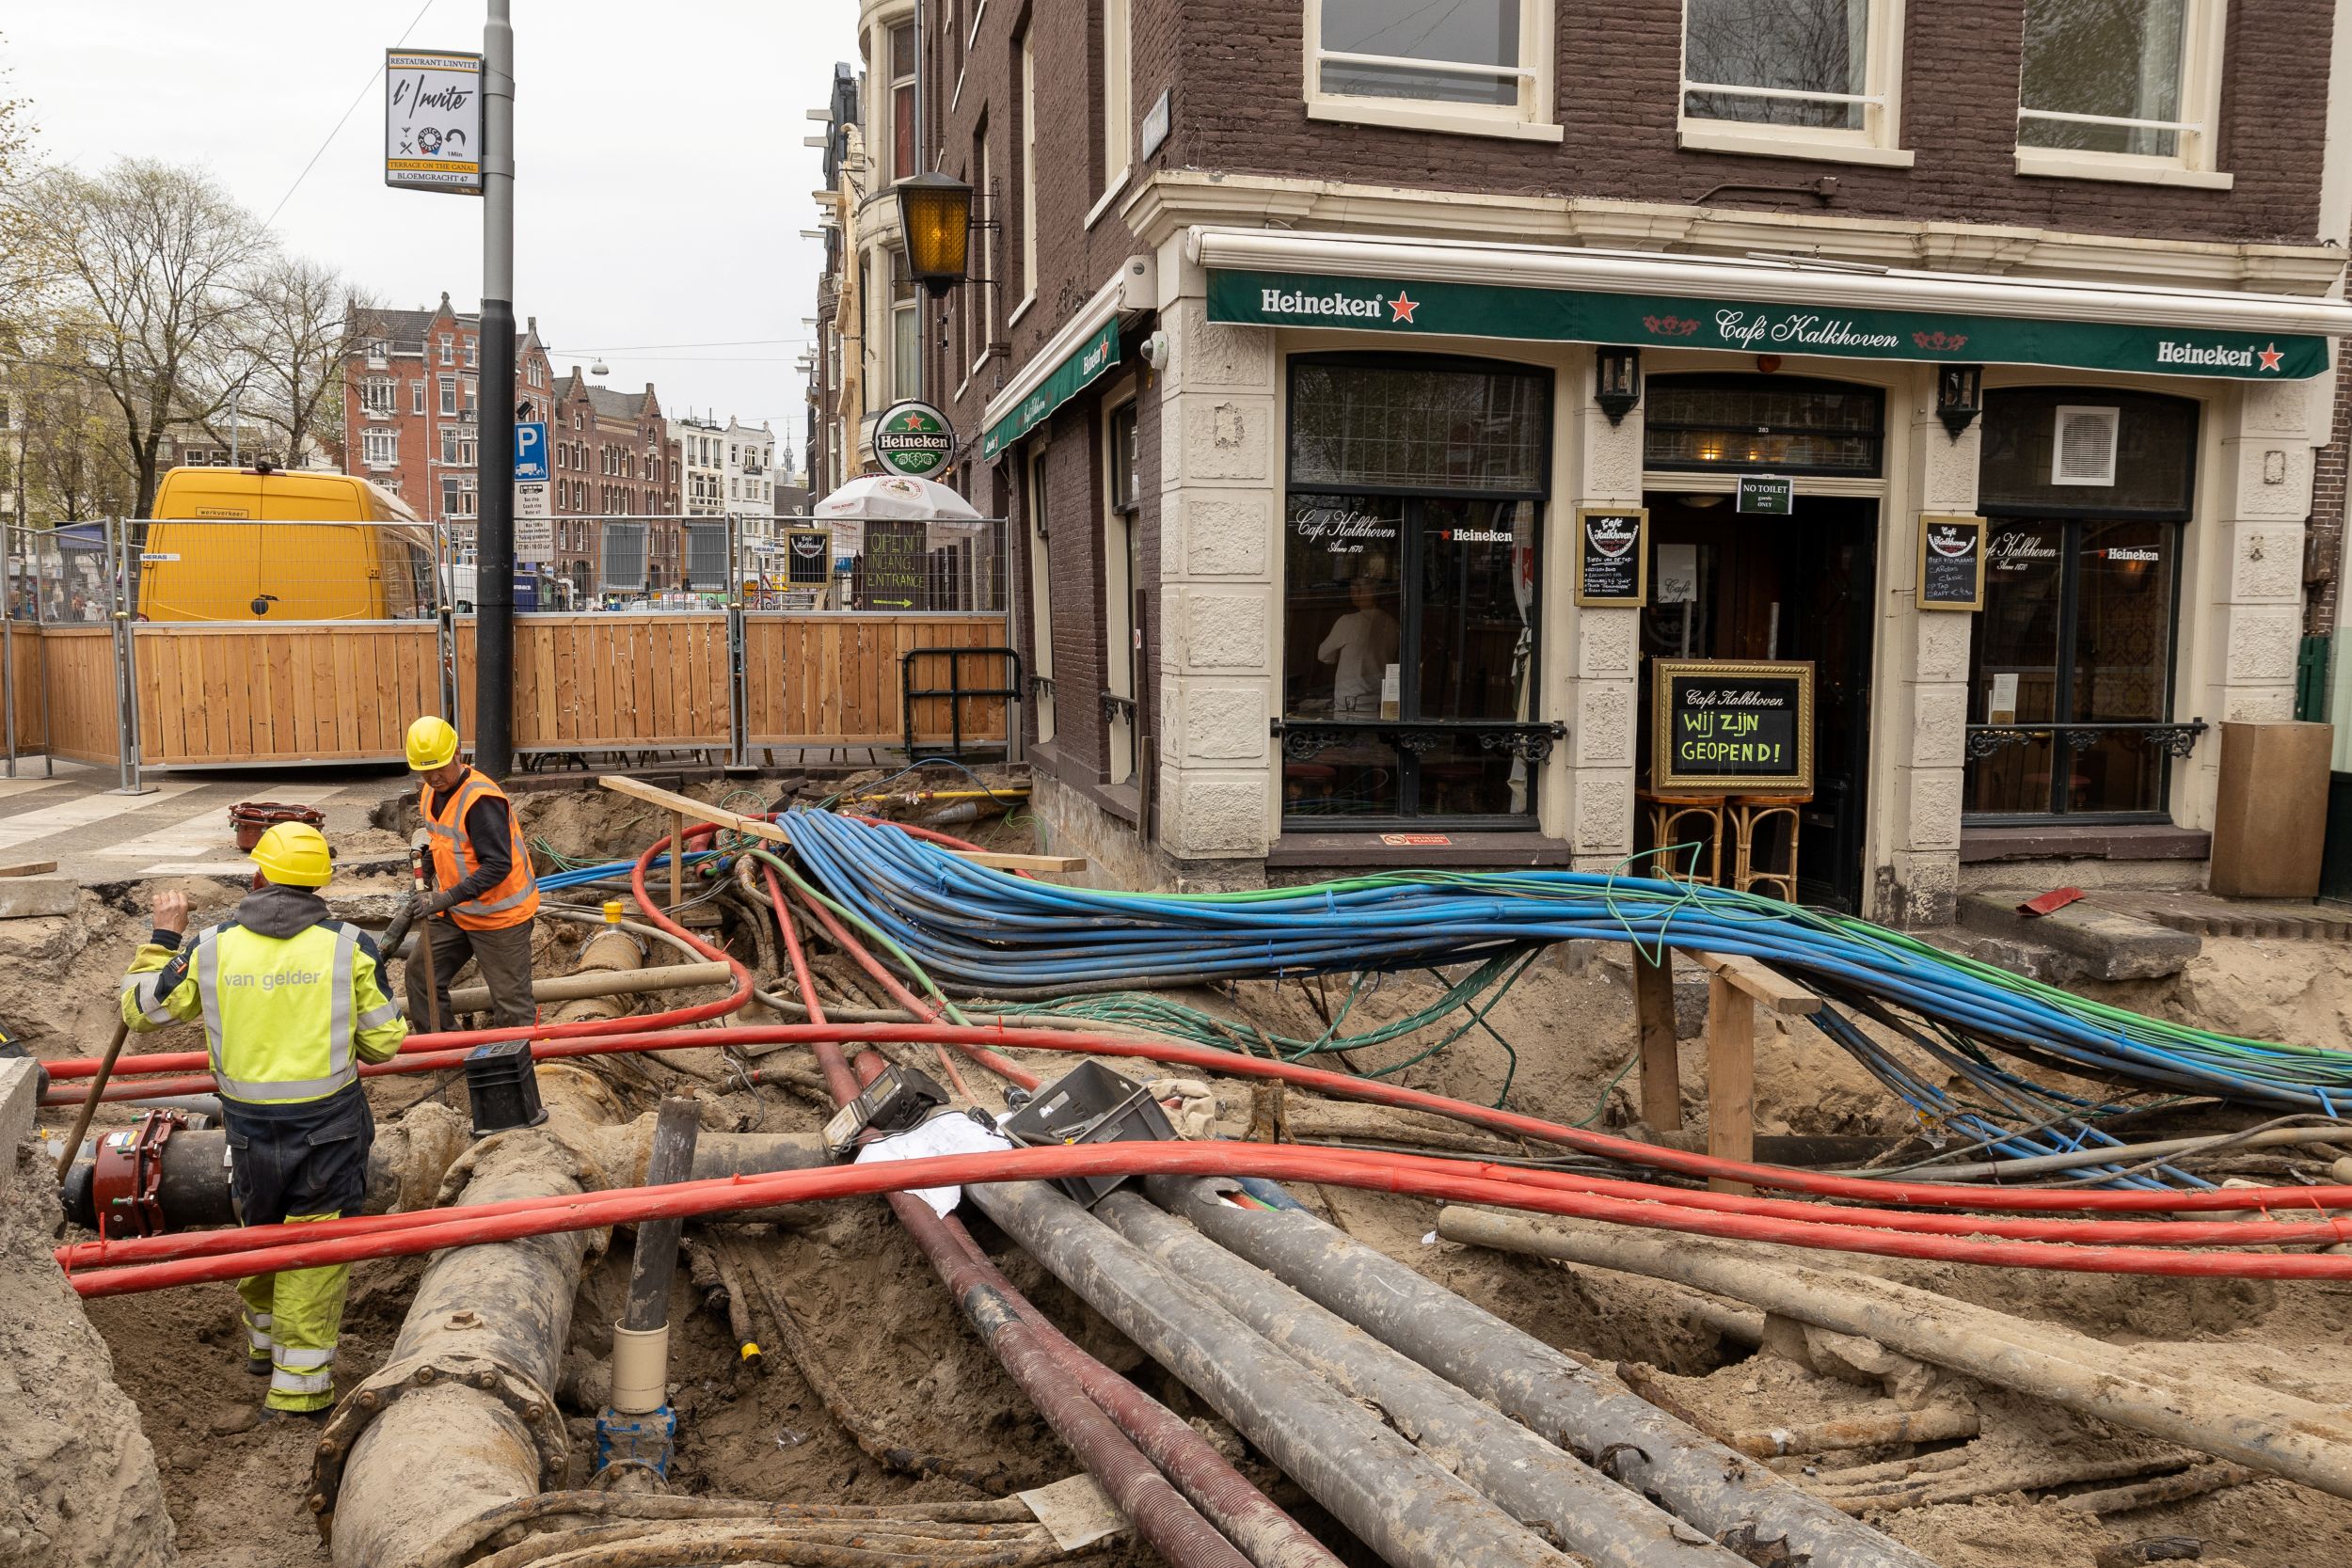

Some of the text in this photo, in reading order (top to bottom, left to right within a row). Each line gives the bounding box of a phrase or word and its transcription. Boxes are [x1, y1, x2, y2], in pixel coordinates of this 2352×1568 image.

[390, 57, 443, 67] RESTAURANT
[397, 173, 459, 182] BLOEMGRACHT
[1262, 289, 1381, 318] Heineken
[1716, 309, 1899, 349] Café Kalkhoven
[2156, 341, 2252, 367] Heineken
[517, 427, 538, 457] P
[881, 435, 948, 449] Heineken
[1758, 485, 1788, 494] TOILET
[1296, 509, 1396, 544] Café Kalkhoven
[1454, 529, 1513, 542] Heineken
[1594, 529, 1632, 540] Kalkhoven
[1997, 532, 2056, 558] Kalkhoven
[2107, 548, 2159, 561] Heineken
[867, 574, 925, 588] ENTRANCE
[1686, 689, 1784, 709] Café Kalkhoven
[1681, 741, 1781, 763] GEOPEND!
[224, 970, 321, 990] van gelder
